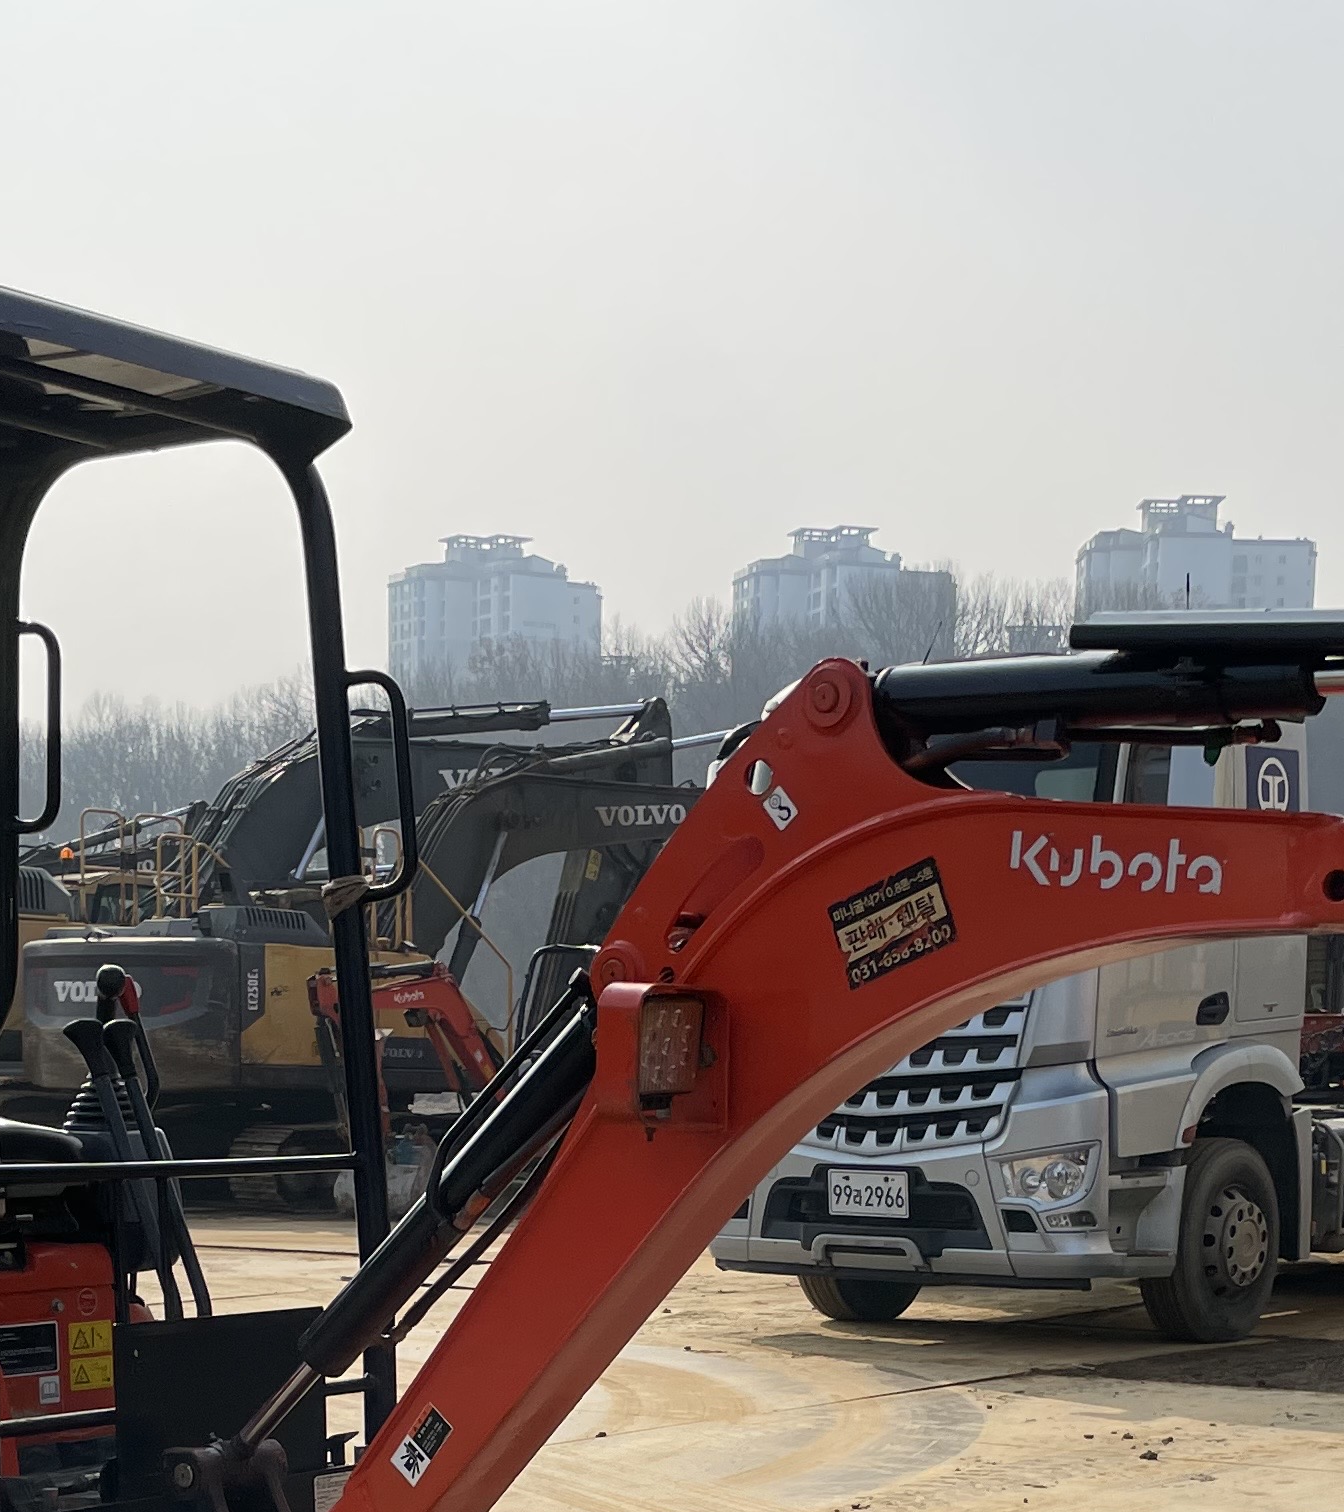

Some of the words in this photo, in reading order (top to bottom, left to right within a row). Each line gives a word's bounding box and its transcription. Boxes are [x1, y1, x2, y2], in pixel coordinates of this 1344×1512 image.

[595, 804, 687, 827] VOLVO
[1009, 830, 1223, 895] Kubota
[53, 980, 142, 1003] VOL
[833, 1184, 905, 1208] 99라2966
